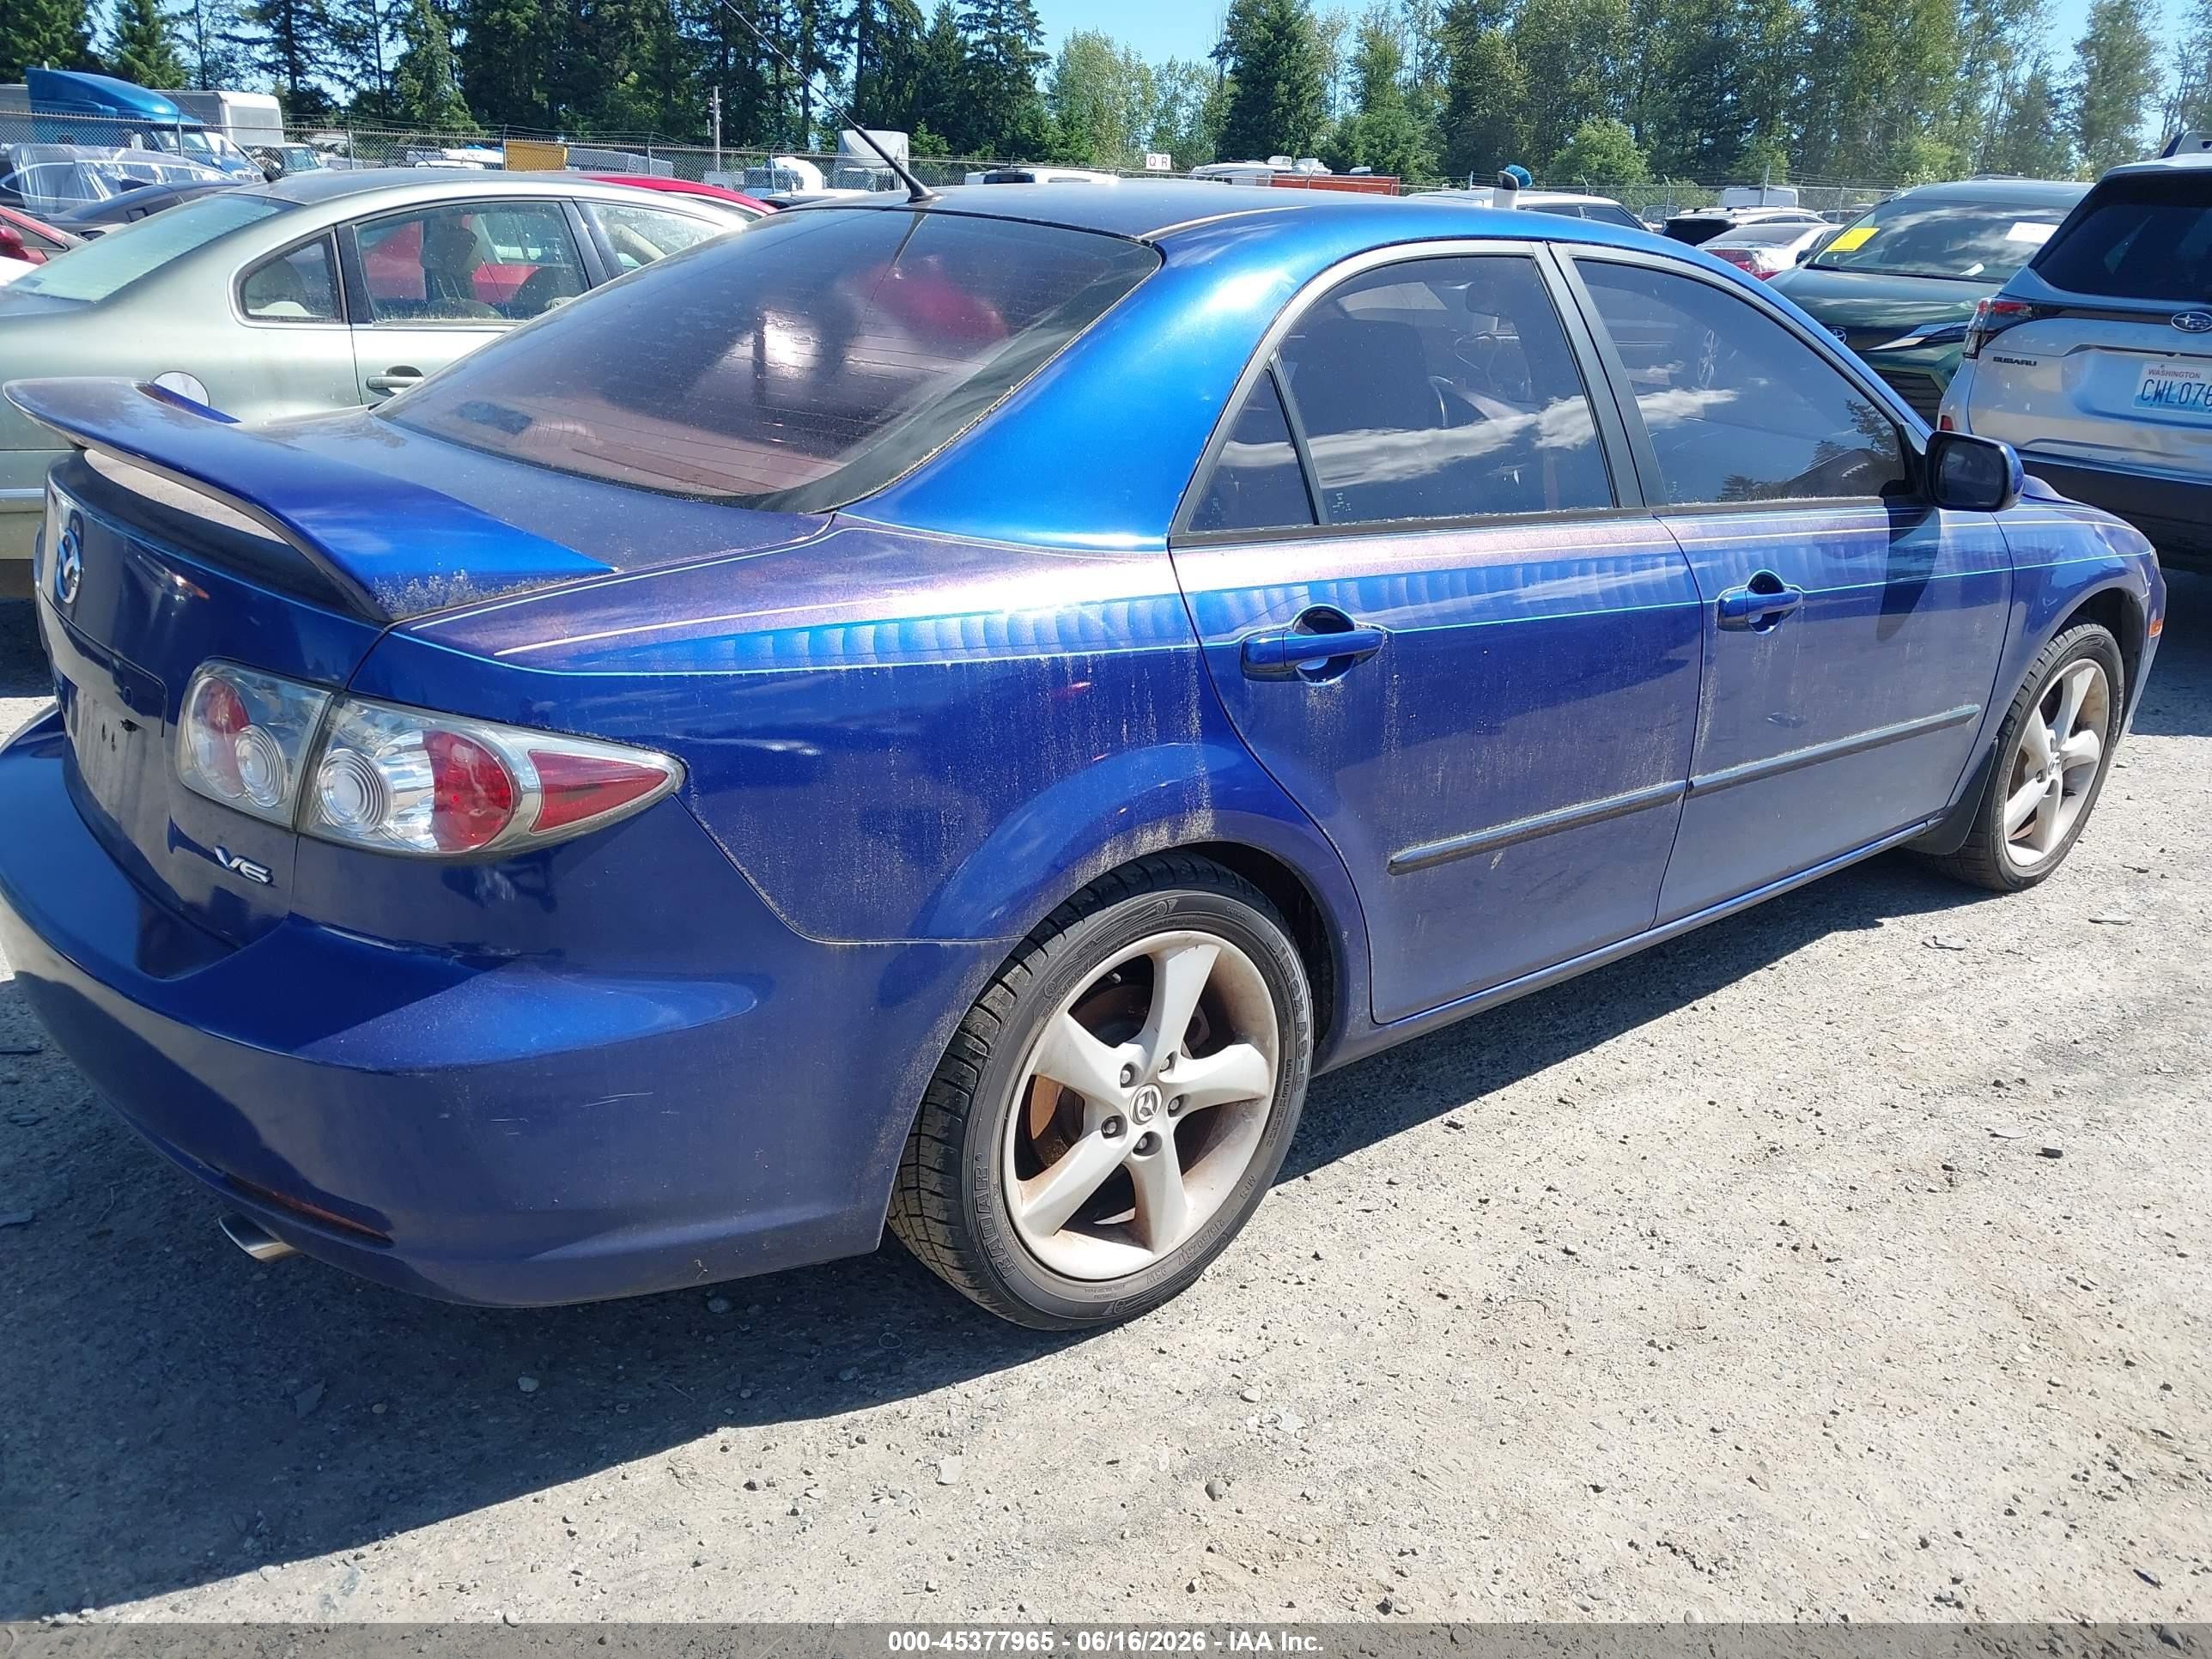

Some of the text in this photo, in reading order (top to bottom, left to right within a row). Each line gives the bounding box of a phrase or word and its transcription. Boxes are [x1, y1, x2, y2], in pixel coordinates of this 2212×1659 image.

[1149, 155, 1168, 167] Q R
[1993, 356, 2037, 367] SUBARU
[2148, 369, 2201, 379] WASHINGTON
[214, 846, 272, 884] V6
[975, 1166, 1016, 1278] RADAR
